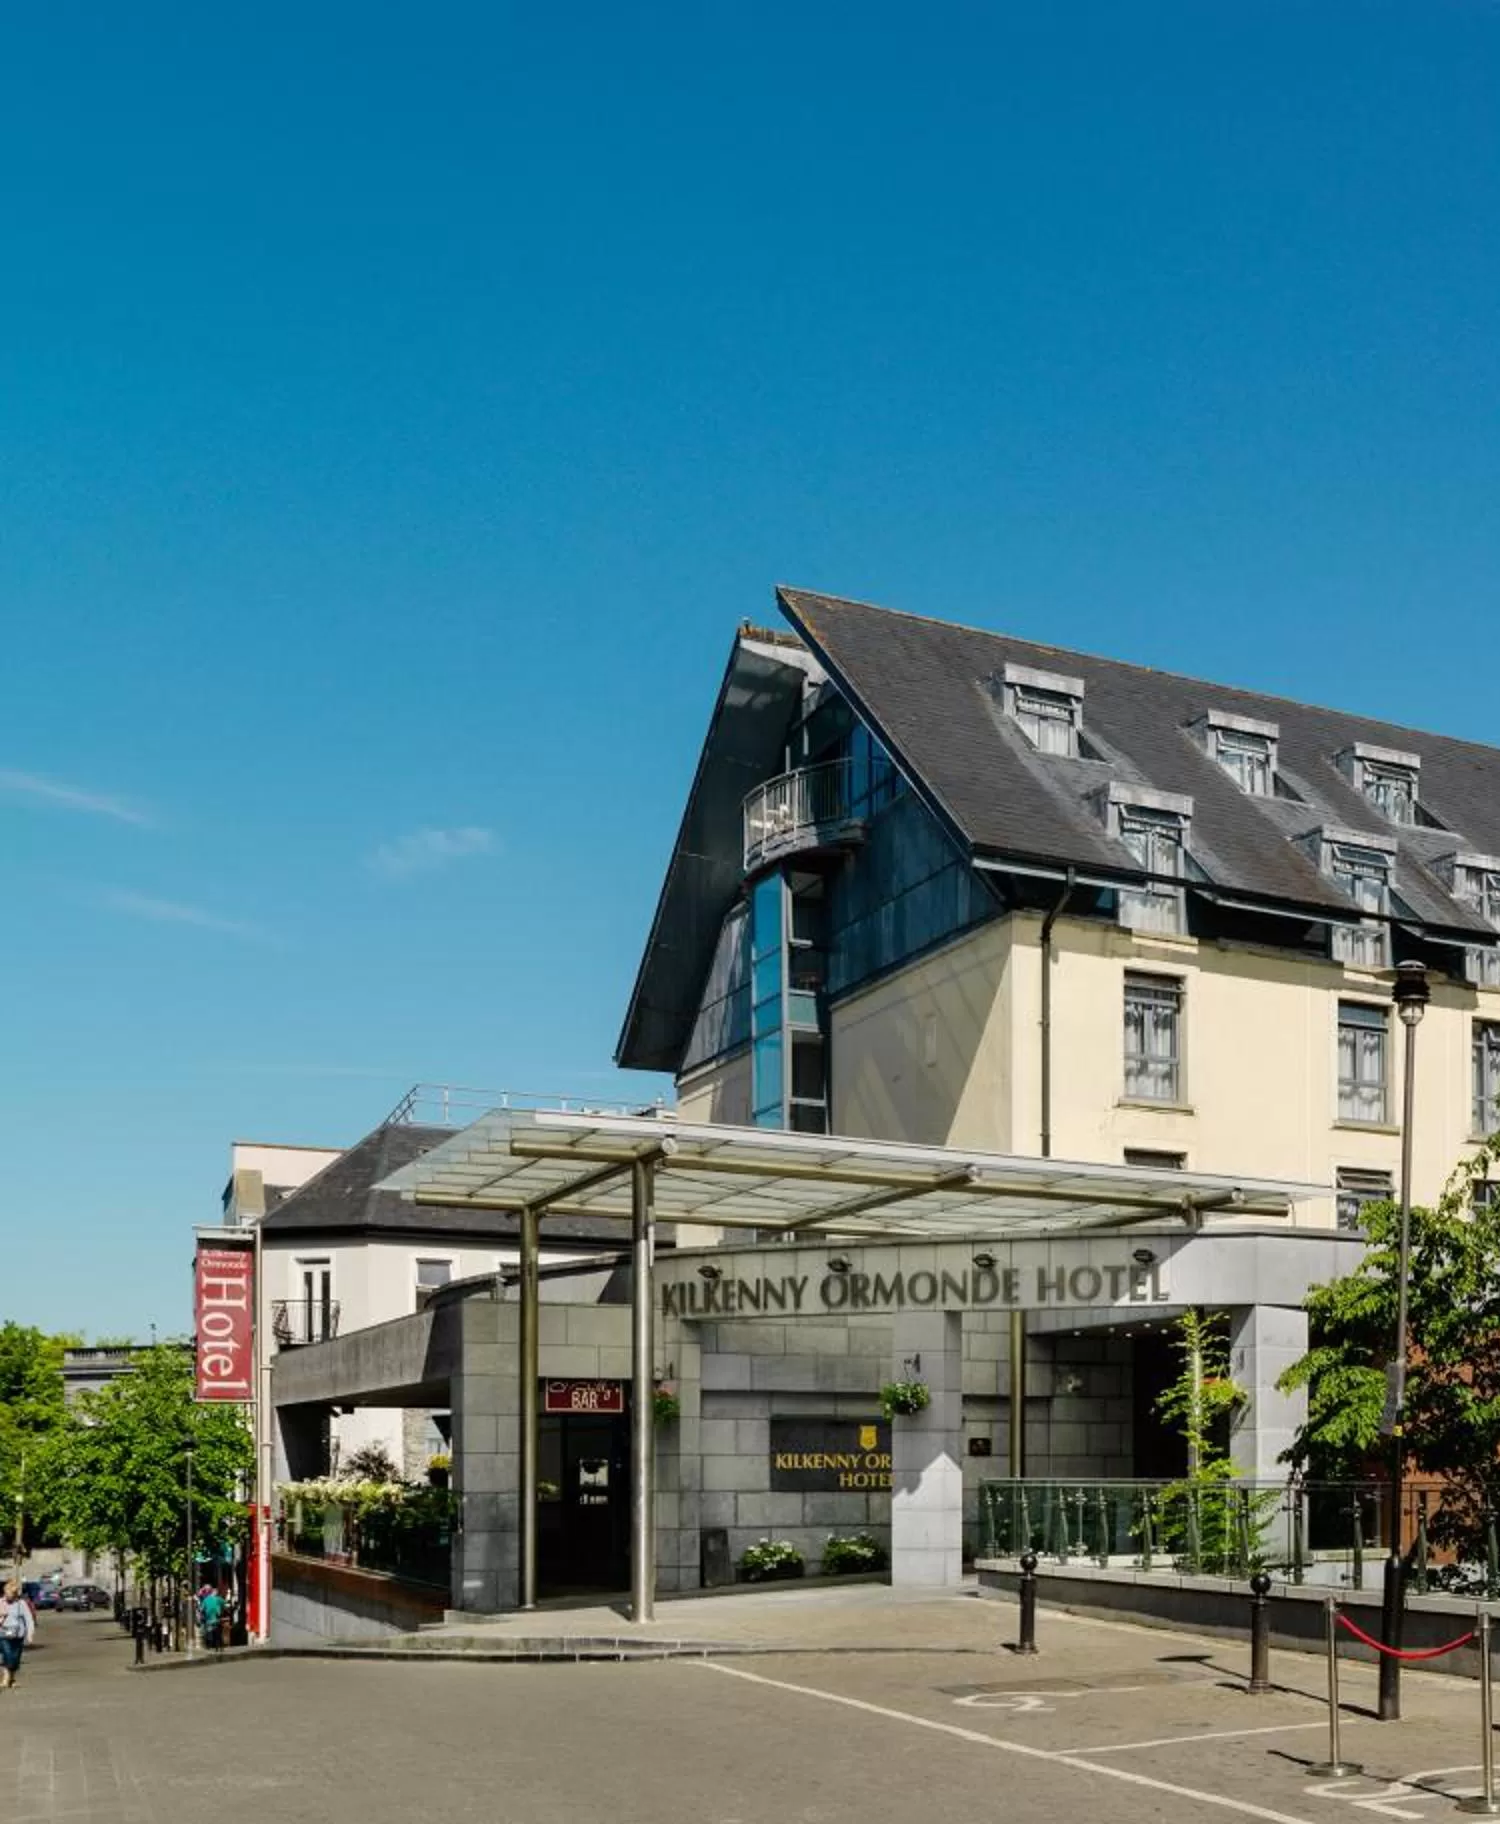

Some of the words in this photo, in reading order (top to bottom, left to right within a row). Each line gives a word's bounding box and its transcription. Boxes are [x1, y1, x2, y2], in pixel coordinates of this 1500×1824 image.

[662, 1276, 808, 1316] KILKENNY
[819, 1267, 1020, 1308] ORMONDE
[1037, 1262, 1169, 1303] HOTEL
[201, 1272, 248, 1392] Hotel
[571, 1391, 598, 1408] BAR
[776, 1454, 861, 1469] KILKENNY
